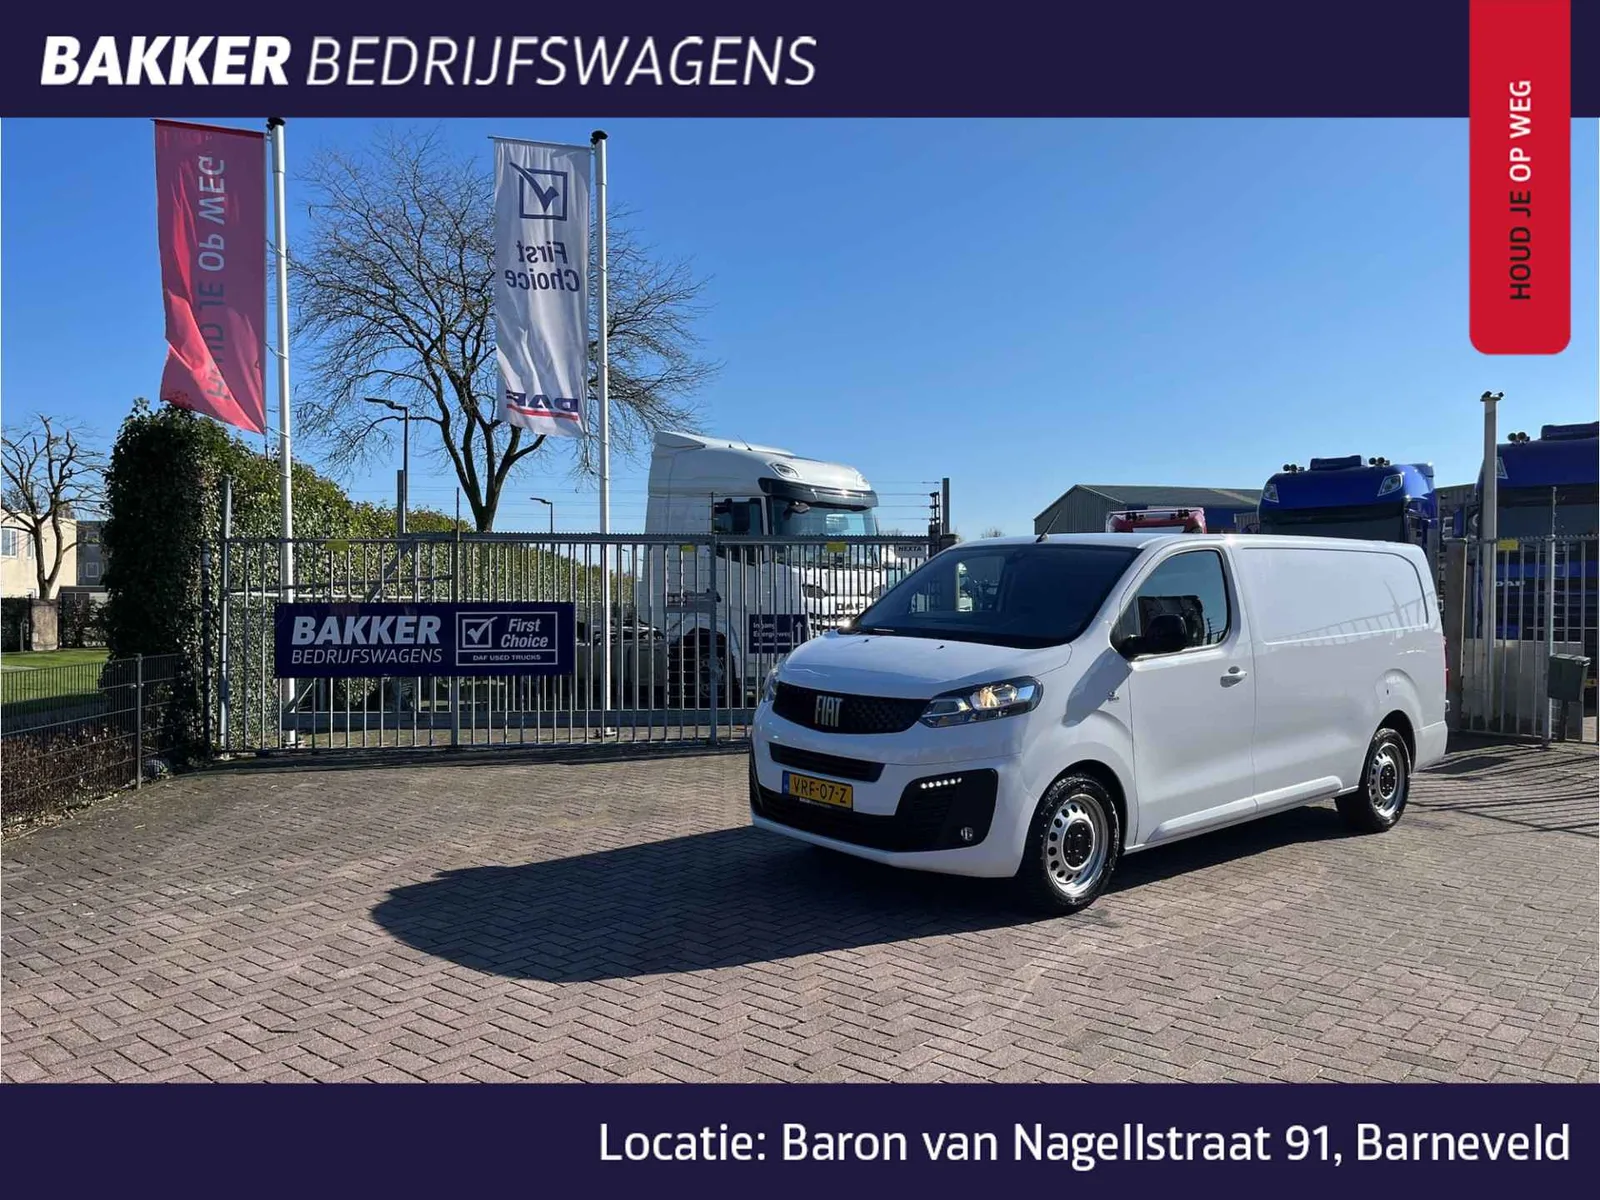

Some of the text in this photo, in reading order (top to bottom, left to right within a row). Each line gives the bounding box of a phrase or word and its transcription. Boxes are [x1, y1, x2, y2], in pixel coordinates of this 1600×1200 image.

[291, 615, 441, 645] BAKKER
[508, 618, 541, 632] First
[500, 634, 549, 648] Choice
[291, 648, 442, 664] BEDRIJFSWAGENS
[814, 694, 844, 727] FIAT
[793, 776, 848, 804] VRF-07-Z
